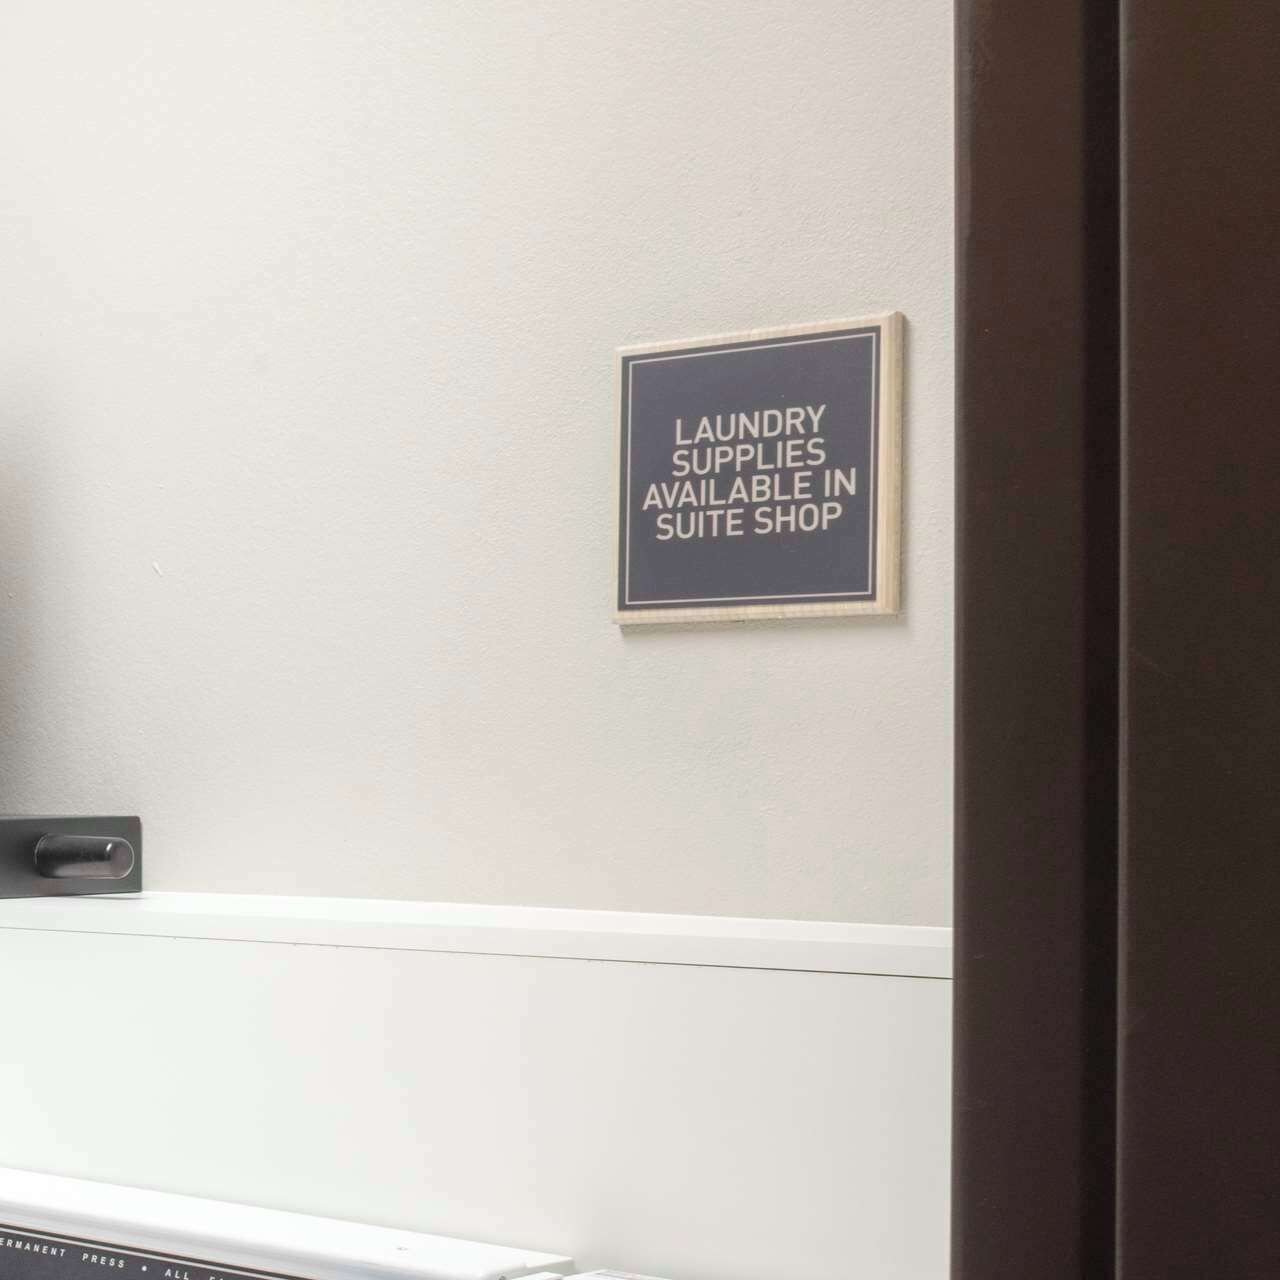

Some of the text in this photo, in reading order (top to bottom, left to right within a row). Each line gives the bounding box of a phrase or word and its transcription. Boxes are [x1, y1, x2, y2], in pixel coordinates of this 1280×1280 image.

[675, 404, 827, 446] LAUNDRY
[671, 438, 826, 477] SUPPLIES
[642, 468, 856, 510] AVAILABLE IN
[656, 502, 842, 540] SUITE SHOP
[82, 1254, 125, 1268] PRESS
[165, 1269, 189, 1280] ALL
